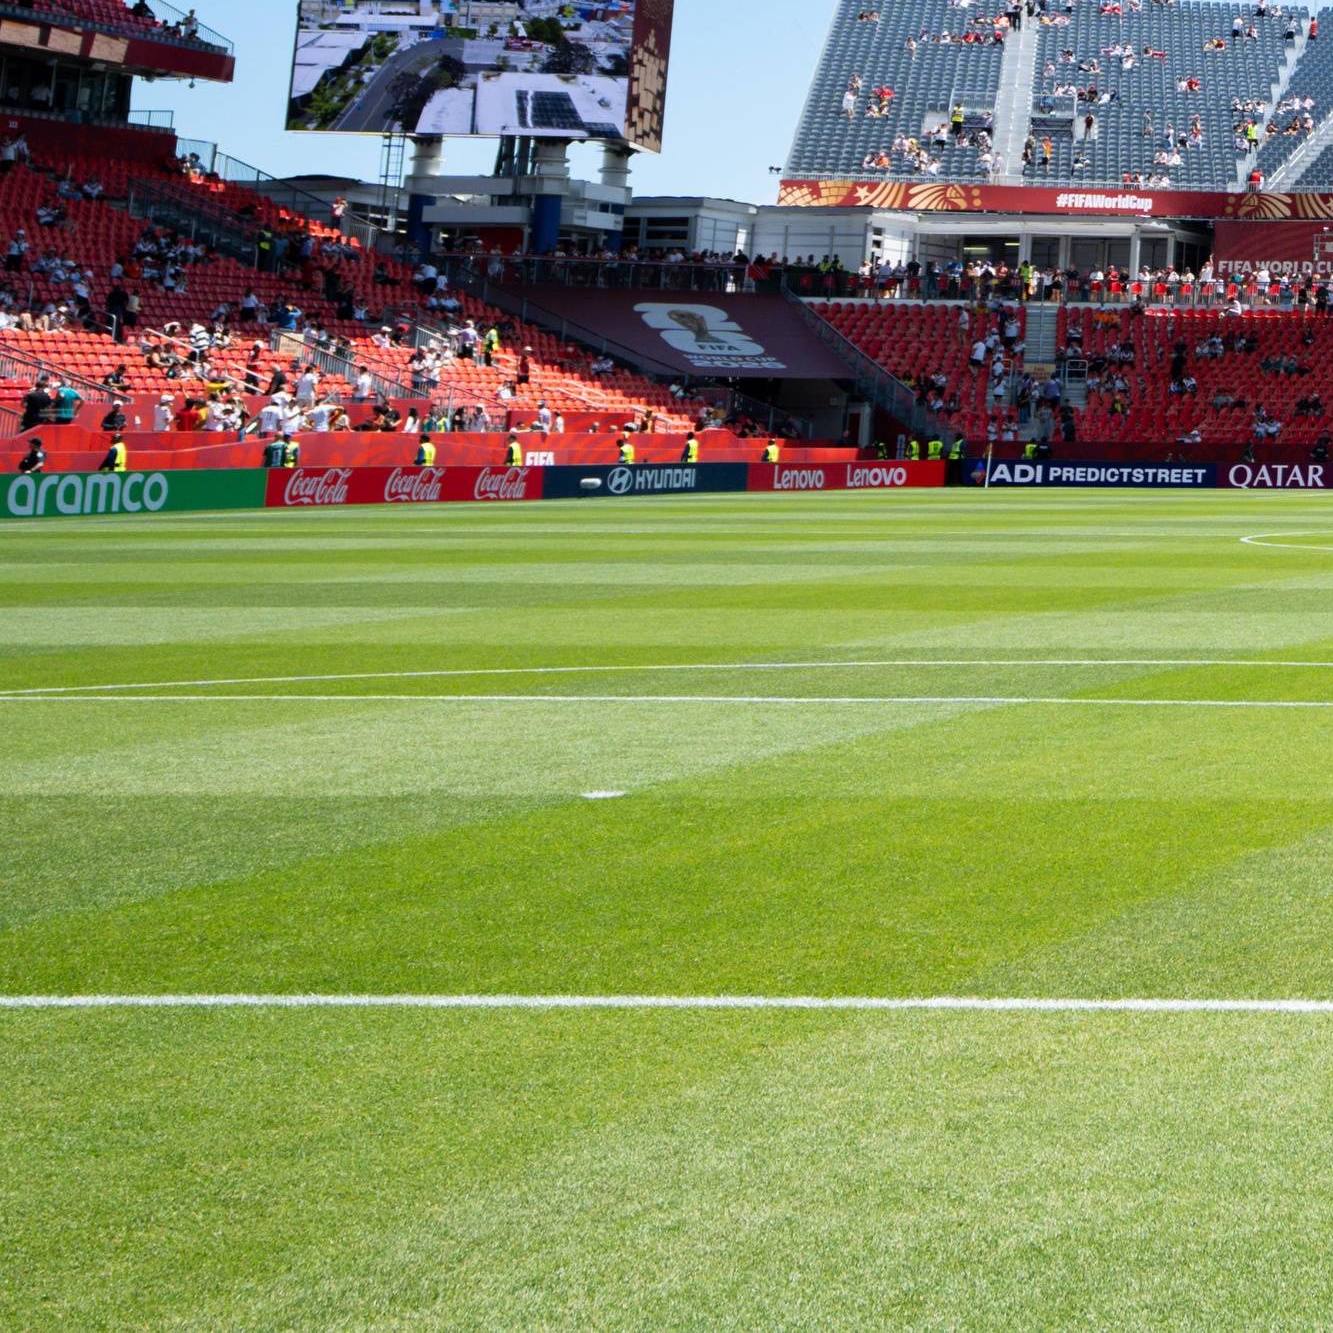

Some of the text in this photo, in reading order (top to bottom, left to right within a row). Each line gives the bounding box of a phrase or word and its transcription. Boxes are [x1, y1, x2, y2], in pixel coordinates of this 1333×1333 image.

[1056, 193, 1152, 212] #FIFAWorldCup
[1218, 260, 1252, 273] FIFA
[525, 451, 555, 466] FIFA
[384, 467, 447, 502] Coca-Cola
[473, 466, 529, 500] Coca-Cola
[635, 468, 696, 490] HYUNDAI
[773, 465, 824, 489] Lenovo
[847, 464, 907, 487] Lenovo
[990, 464, 1206, 484] ADI PREDICTSTREET
[1228, 464, 1324, 489] QATAR
[7, 472, 168, 516] aramco
[284, 467, 353, 505] Coca-Cola
